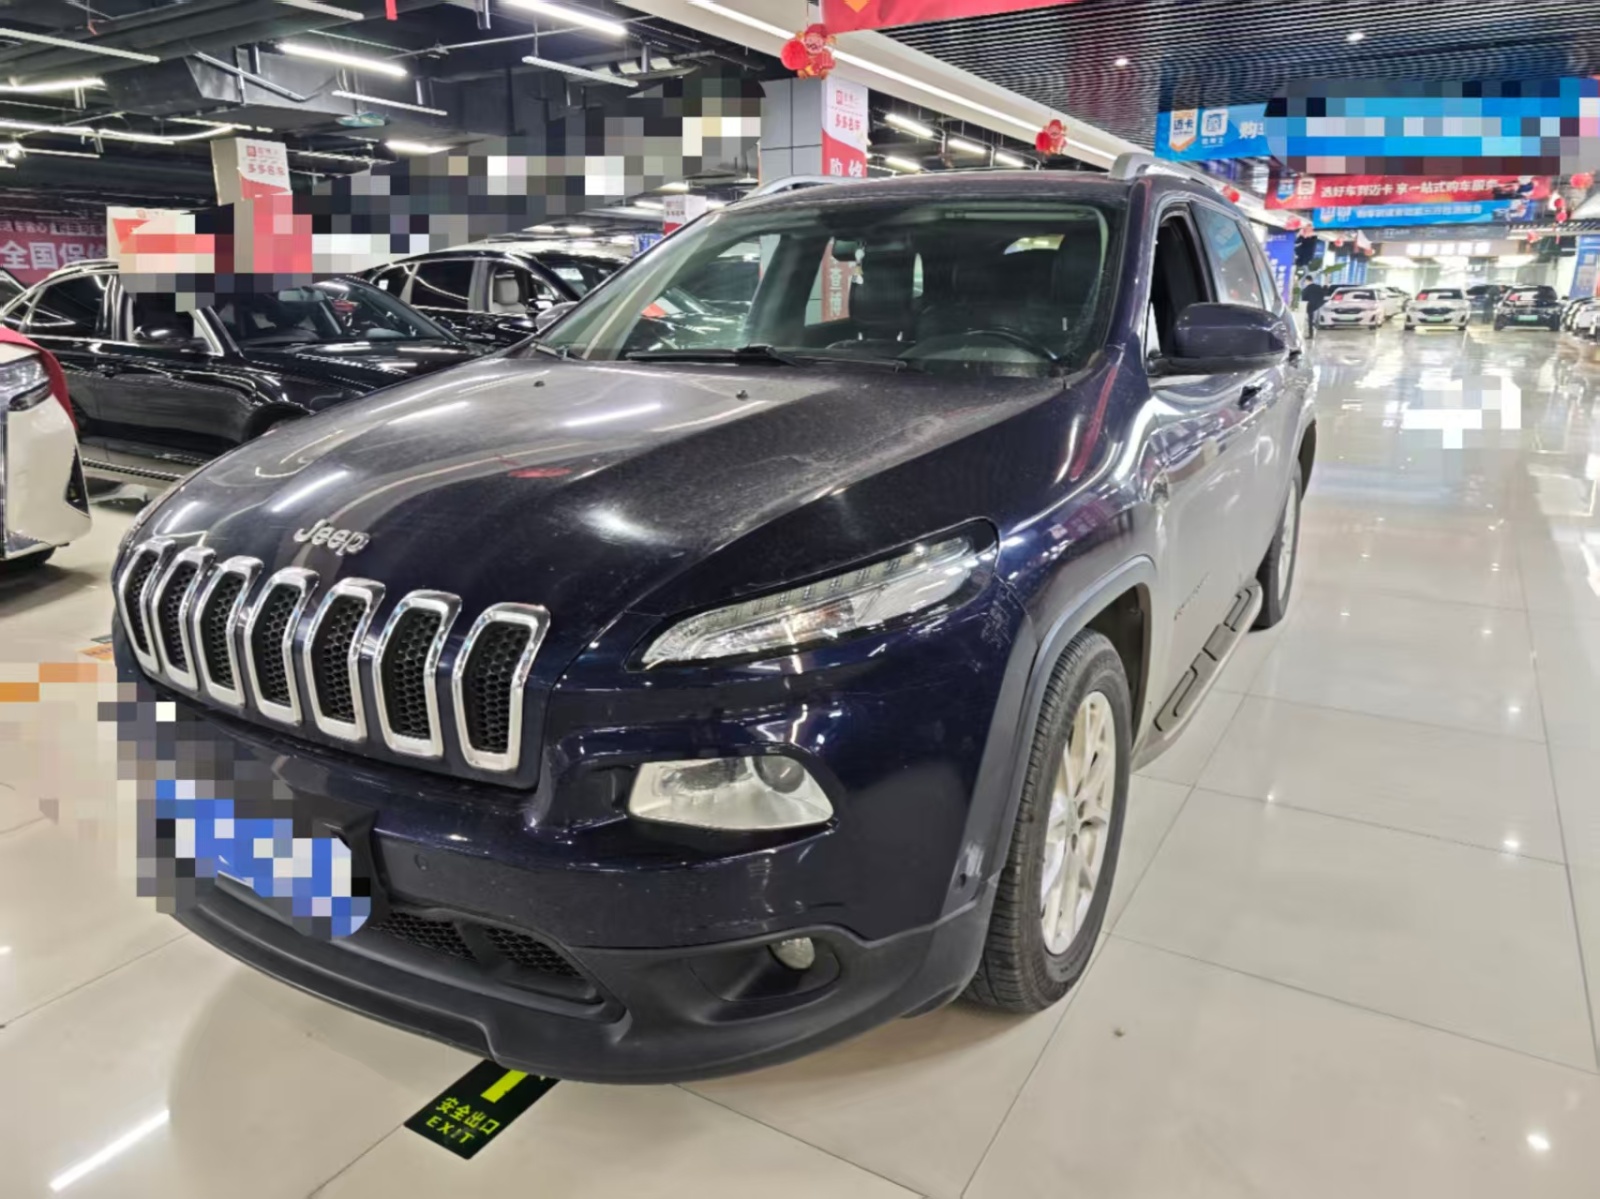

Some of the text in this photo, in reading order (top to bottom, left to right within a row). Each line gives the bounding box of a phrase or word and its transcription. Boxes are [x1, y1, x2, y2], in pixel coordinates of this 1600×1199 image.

[293, 518, 370, 556] Jeep
[425, 1115, 475, 1144] EXIT
[435, 1097, 500, 1135] 安全出口
